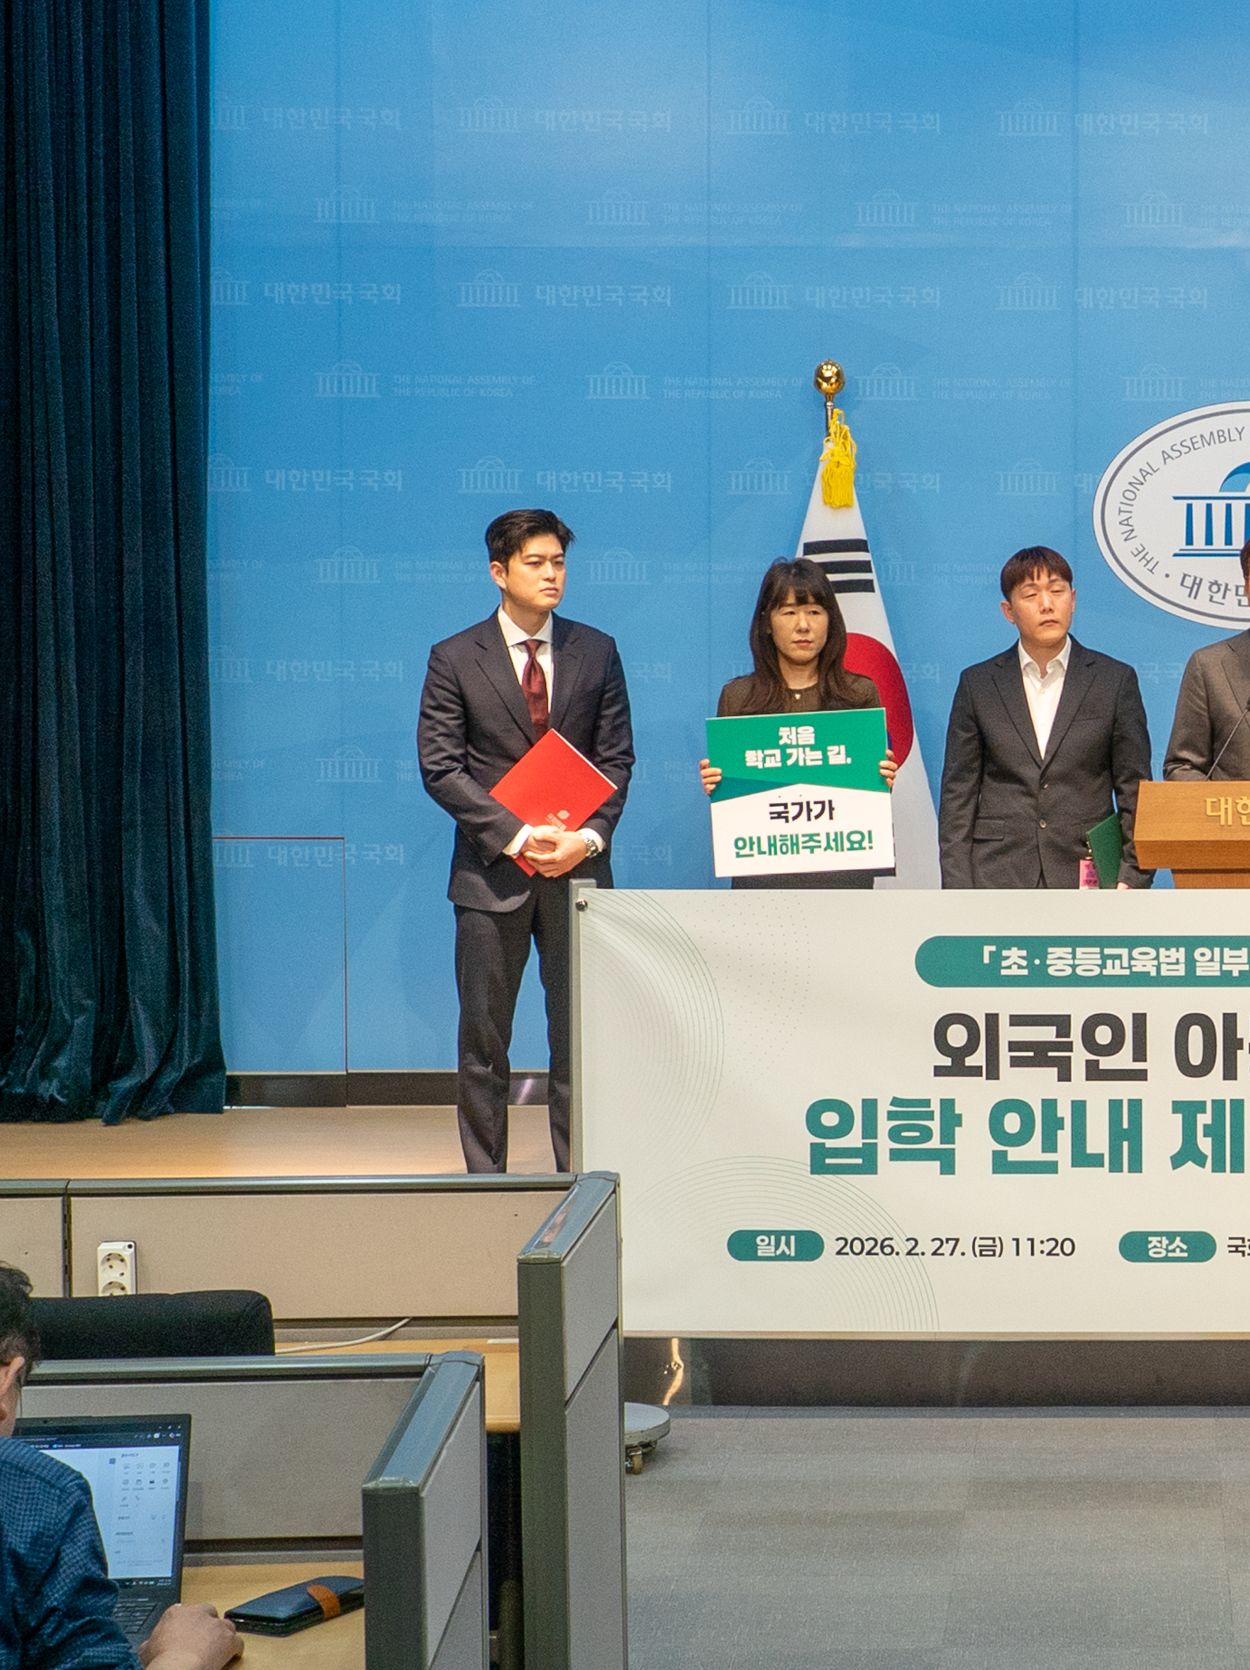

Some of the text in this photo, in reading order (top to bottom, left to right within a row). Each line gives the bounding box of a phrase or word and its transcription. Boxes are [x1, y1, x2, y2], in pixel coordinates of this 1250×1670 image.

[1160, 425, 1246, 466] ASSEMBLY
[1117, 460, 1161, 542] NATIONAL
[1131, 543, 1161, 575] THE
[778, 726, 816, 746] 처음
[745, 745, 852, 769] 학교 가는 길.
[769, 799, 835, 823] 국가가
[734, 830, 873, 858] 안내해주세요!
[934, 1013, 1148, 1082] 외국인
[806, 1097, 962, 1175] 입학
[989, 1099, 1142, 1174] 안내
[755, 1234, 797, 1258] 일시
[835, 1237, 1075, 1257] 2026. 2. 27. (금) 11:20
[1147, 1235, 1188, 1258] 장소
